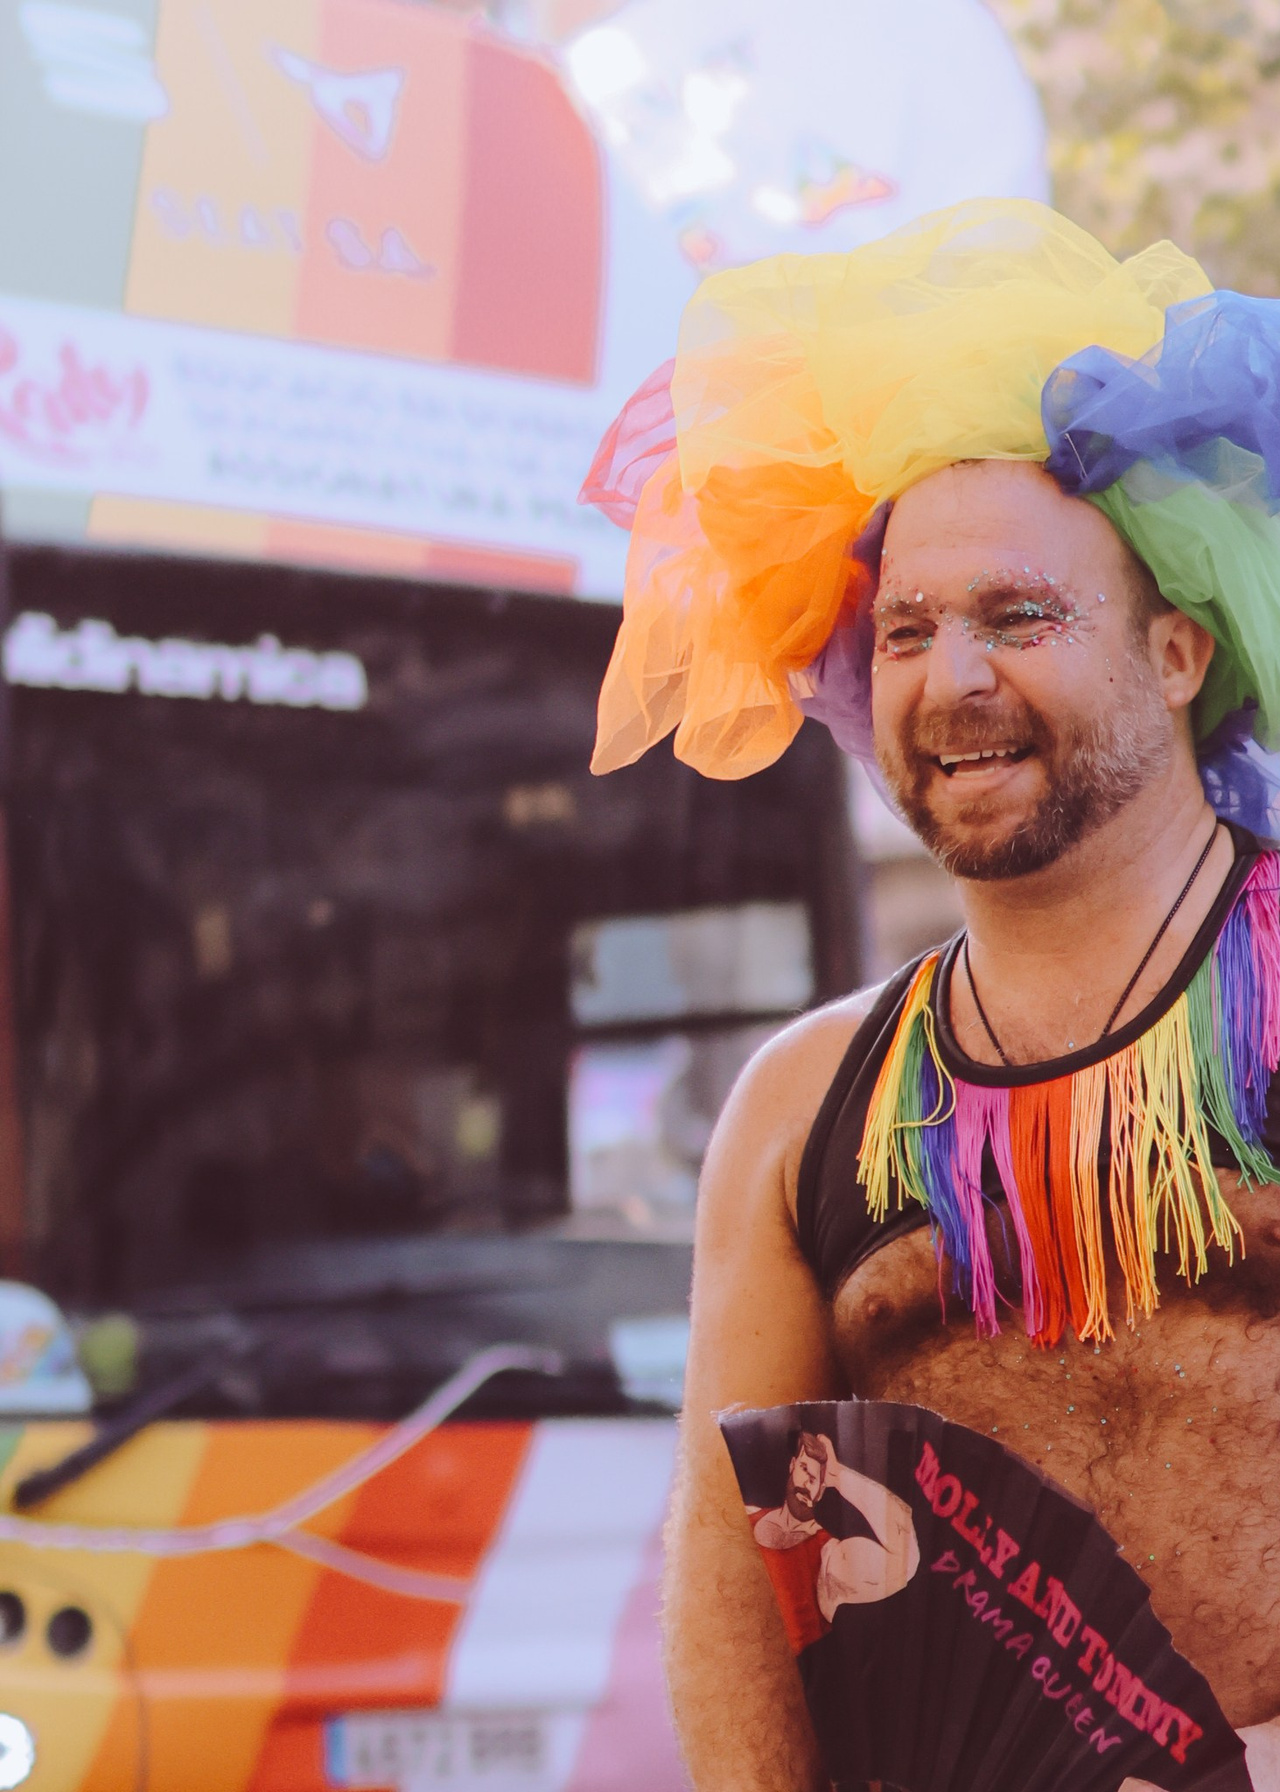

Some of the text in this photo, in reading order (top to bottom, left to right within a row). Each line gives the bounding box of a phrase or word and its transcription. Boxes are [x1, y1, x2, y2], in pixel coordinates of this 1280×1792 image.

[915, 1441, 1203, 1765] MOLLY AND TOMMY
[930, 1550, 1122, 1754] DRAMA QUEEN
